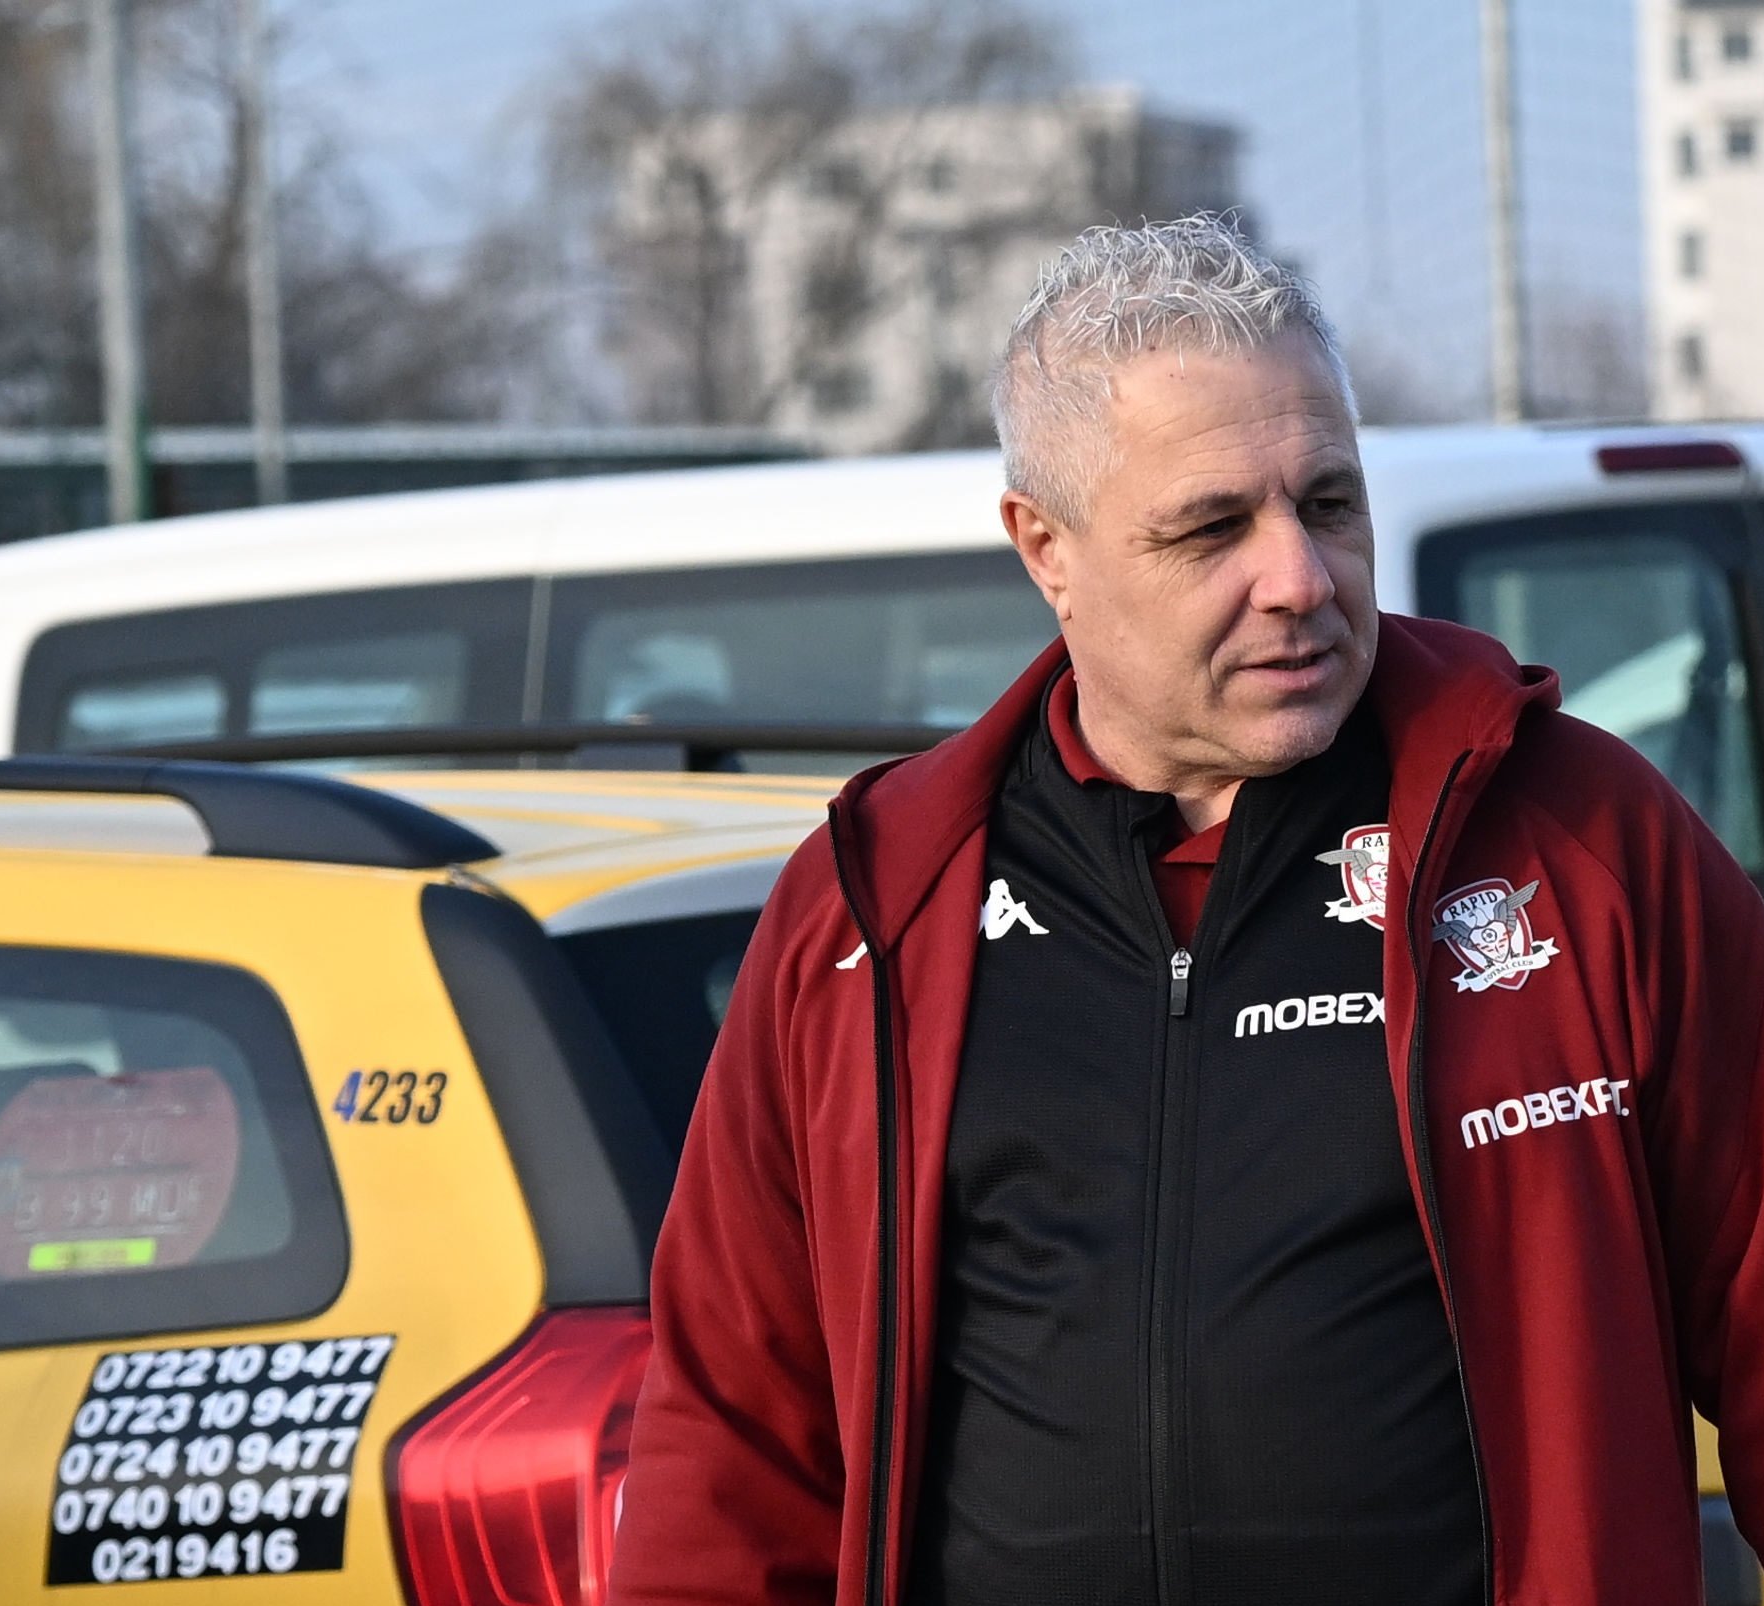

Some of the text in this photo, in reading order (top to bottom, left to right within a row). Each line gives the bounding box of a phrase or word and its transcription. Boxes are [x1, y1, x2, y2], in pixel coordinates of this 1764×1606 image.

[1362, 834, 1389, 849] RA
[1447, 891, 1498, 919] RAPID
[333, 1070, 448, 1124] 4233
[92, 1335, 394, 1393] 0722 10 9477
[74, 1381, 376, 1438] 0723 10 9477
[58, 1426, 361, 1486] 0724 10 9477
[53, 1473, 351, 1536] 0740 10 9477
